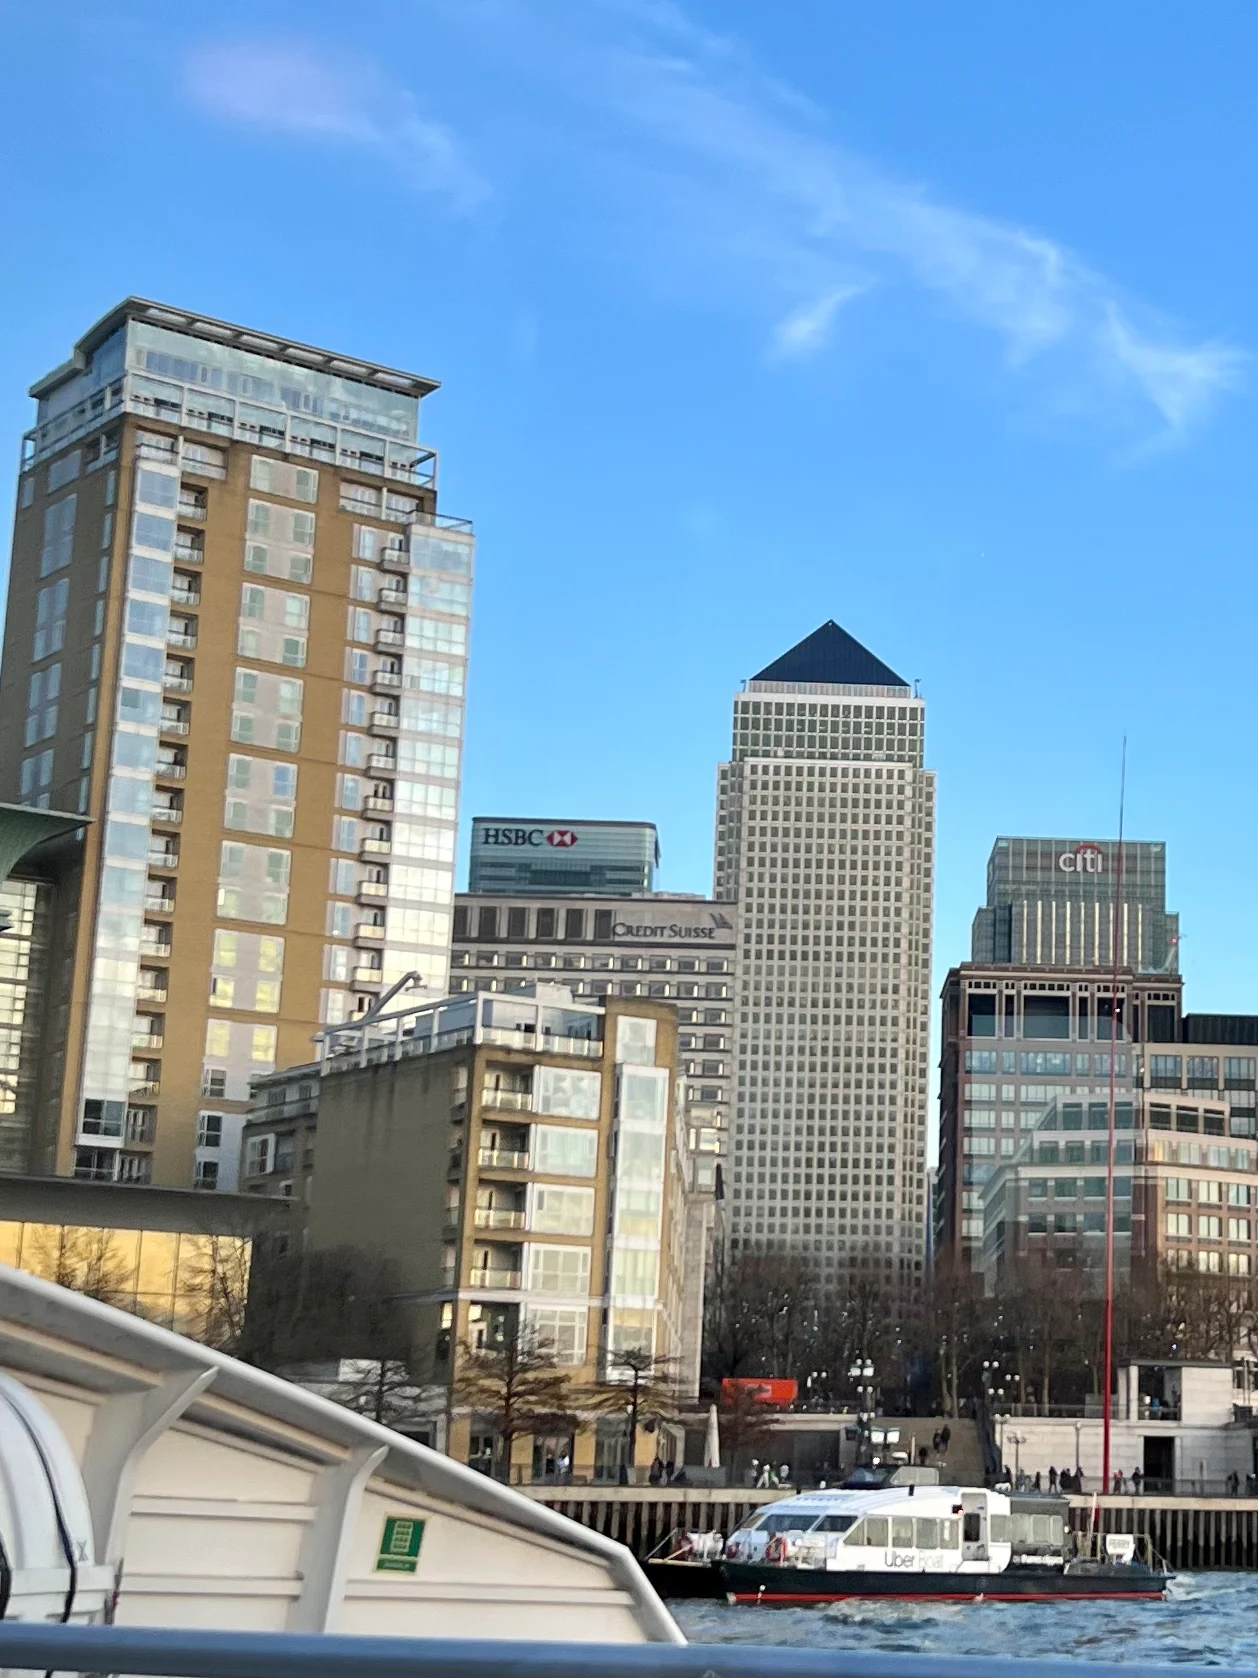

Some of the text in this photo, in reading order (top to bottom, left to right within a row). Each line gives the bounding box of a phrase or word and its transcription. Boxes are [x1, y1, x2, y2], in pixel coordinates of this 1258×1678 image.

[482, 827, 544, 847] HSBC
[1058, 847, 1103, 873] citi
[612, 922, 716, 940] CREDIT SUISSE
[884, 1550, 916, 1568] Uber
